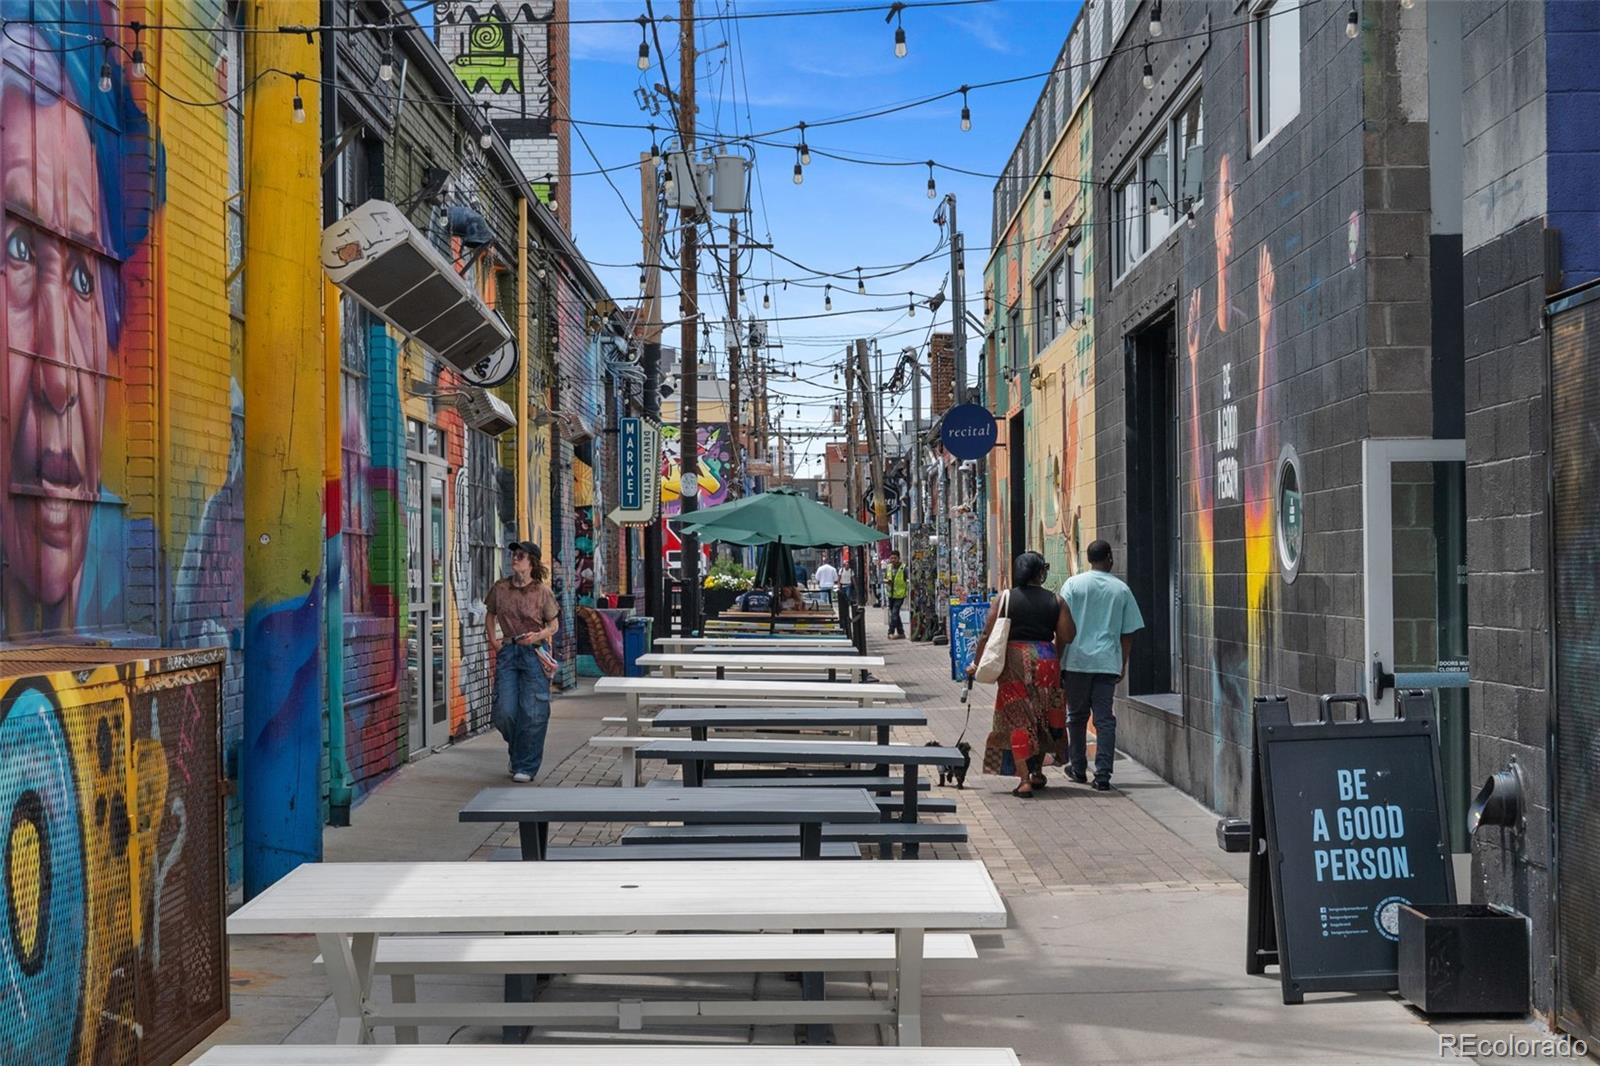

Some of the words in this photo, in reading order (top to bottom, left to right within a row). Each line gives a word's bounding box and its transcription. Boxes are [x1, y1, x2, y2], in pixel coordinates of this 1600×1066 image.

[643, 430, 651, 463] DENVER
[948, 423, 990, 437] recital
[626, 422, 635, 504] MARKET
[643, 468, 651, 504] CENTRAL
[1337, 768, 1369, 801] BE
[1313, 808, 1330, 842] A
[1337, 805, 1404, 841] GOOD
[1314, 846, 1415, 882] PERSON.
